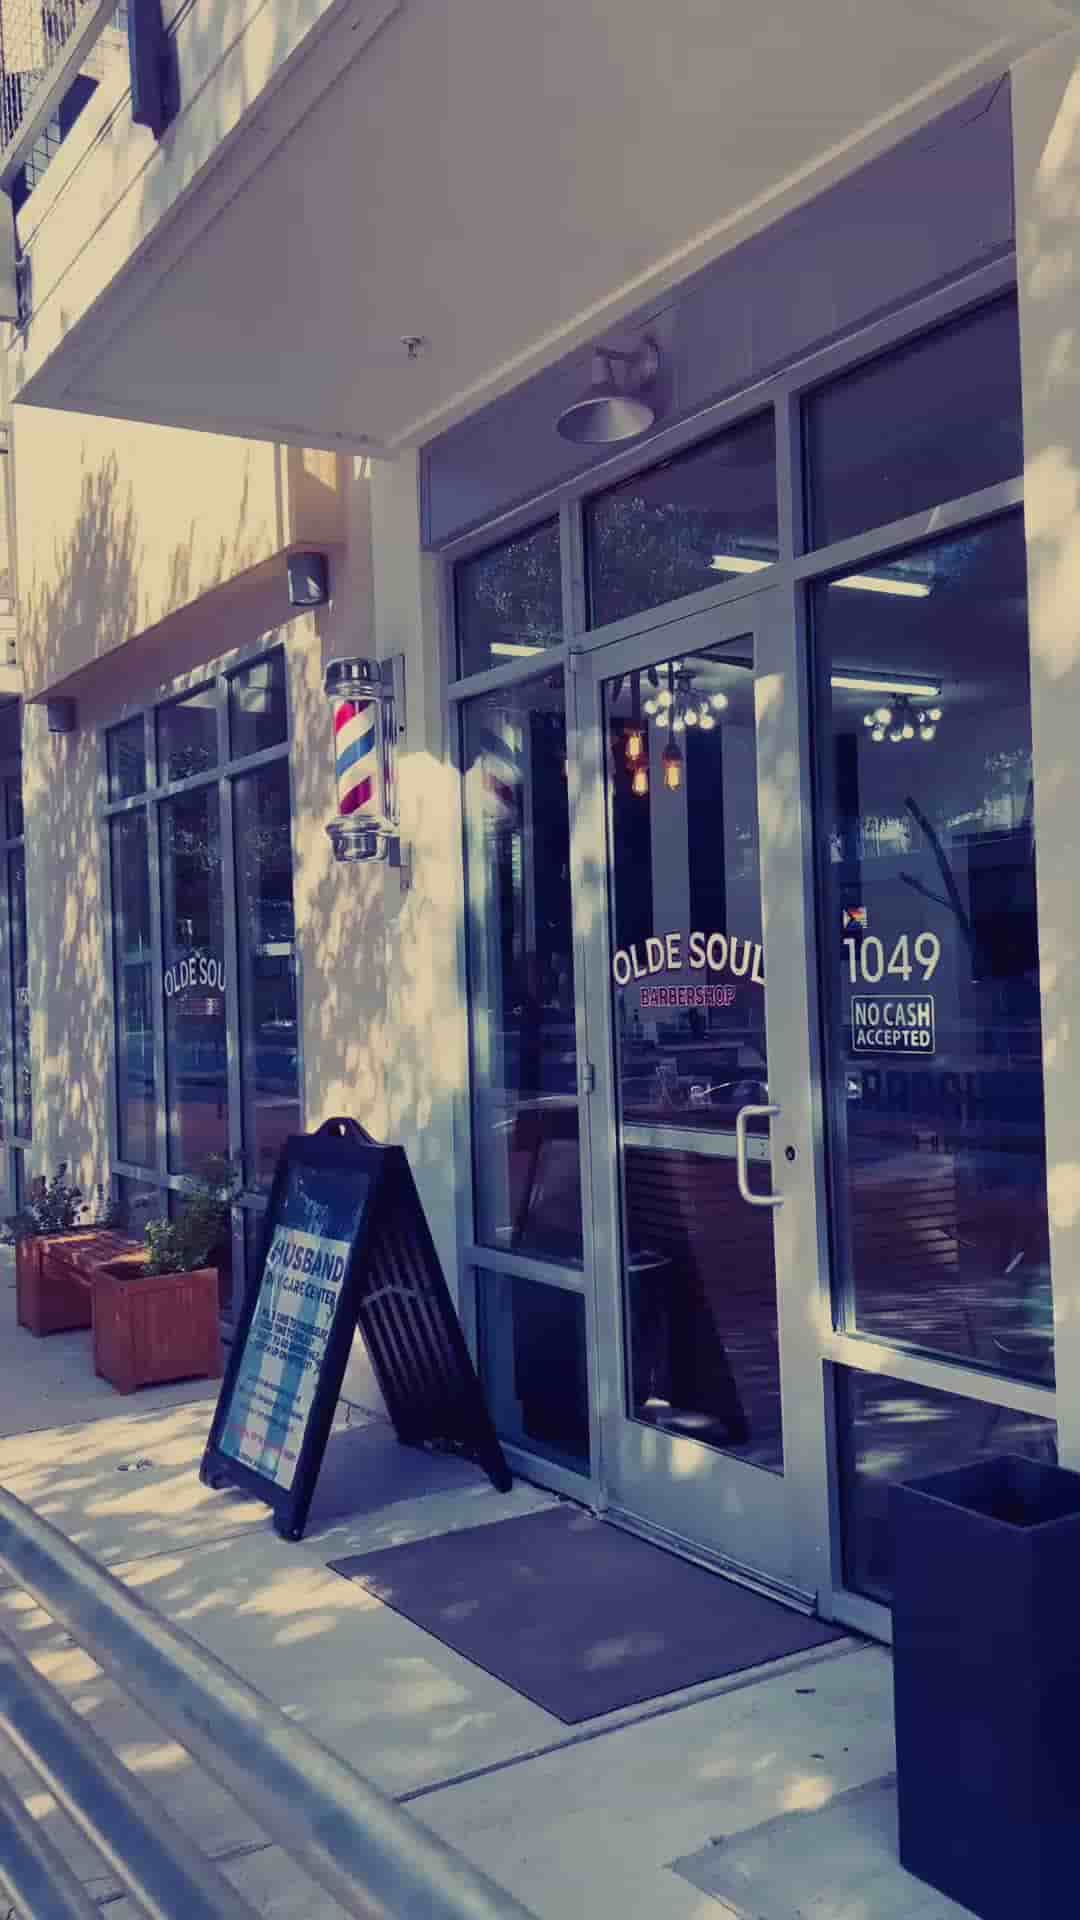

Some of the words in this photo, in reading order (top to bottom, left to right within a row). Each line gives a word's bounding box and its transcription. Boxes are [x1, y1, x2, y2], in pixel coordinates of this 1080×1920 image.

[613, 933, 682, 985] OLDE
[689, 931, 766, 986] SOUL
[843, 932, 941, 983] 1049
[164, 958, 197, 997] OLDE
[199, 958, 225, 992] SOU
[640, 984, 737, 1008] BARBERSHOP
[855, 1003, 880, 1026] NO
[884, 1003, 930, 1027] CASH
[856, 1029, 931, 1047] ACCEPTED
[271, 1240, 345, 1282] HUSBAND
[282, 1277, 305, 1297] CARE
[304, 1283, 337, 1305] CENTER
